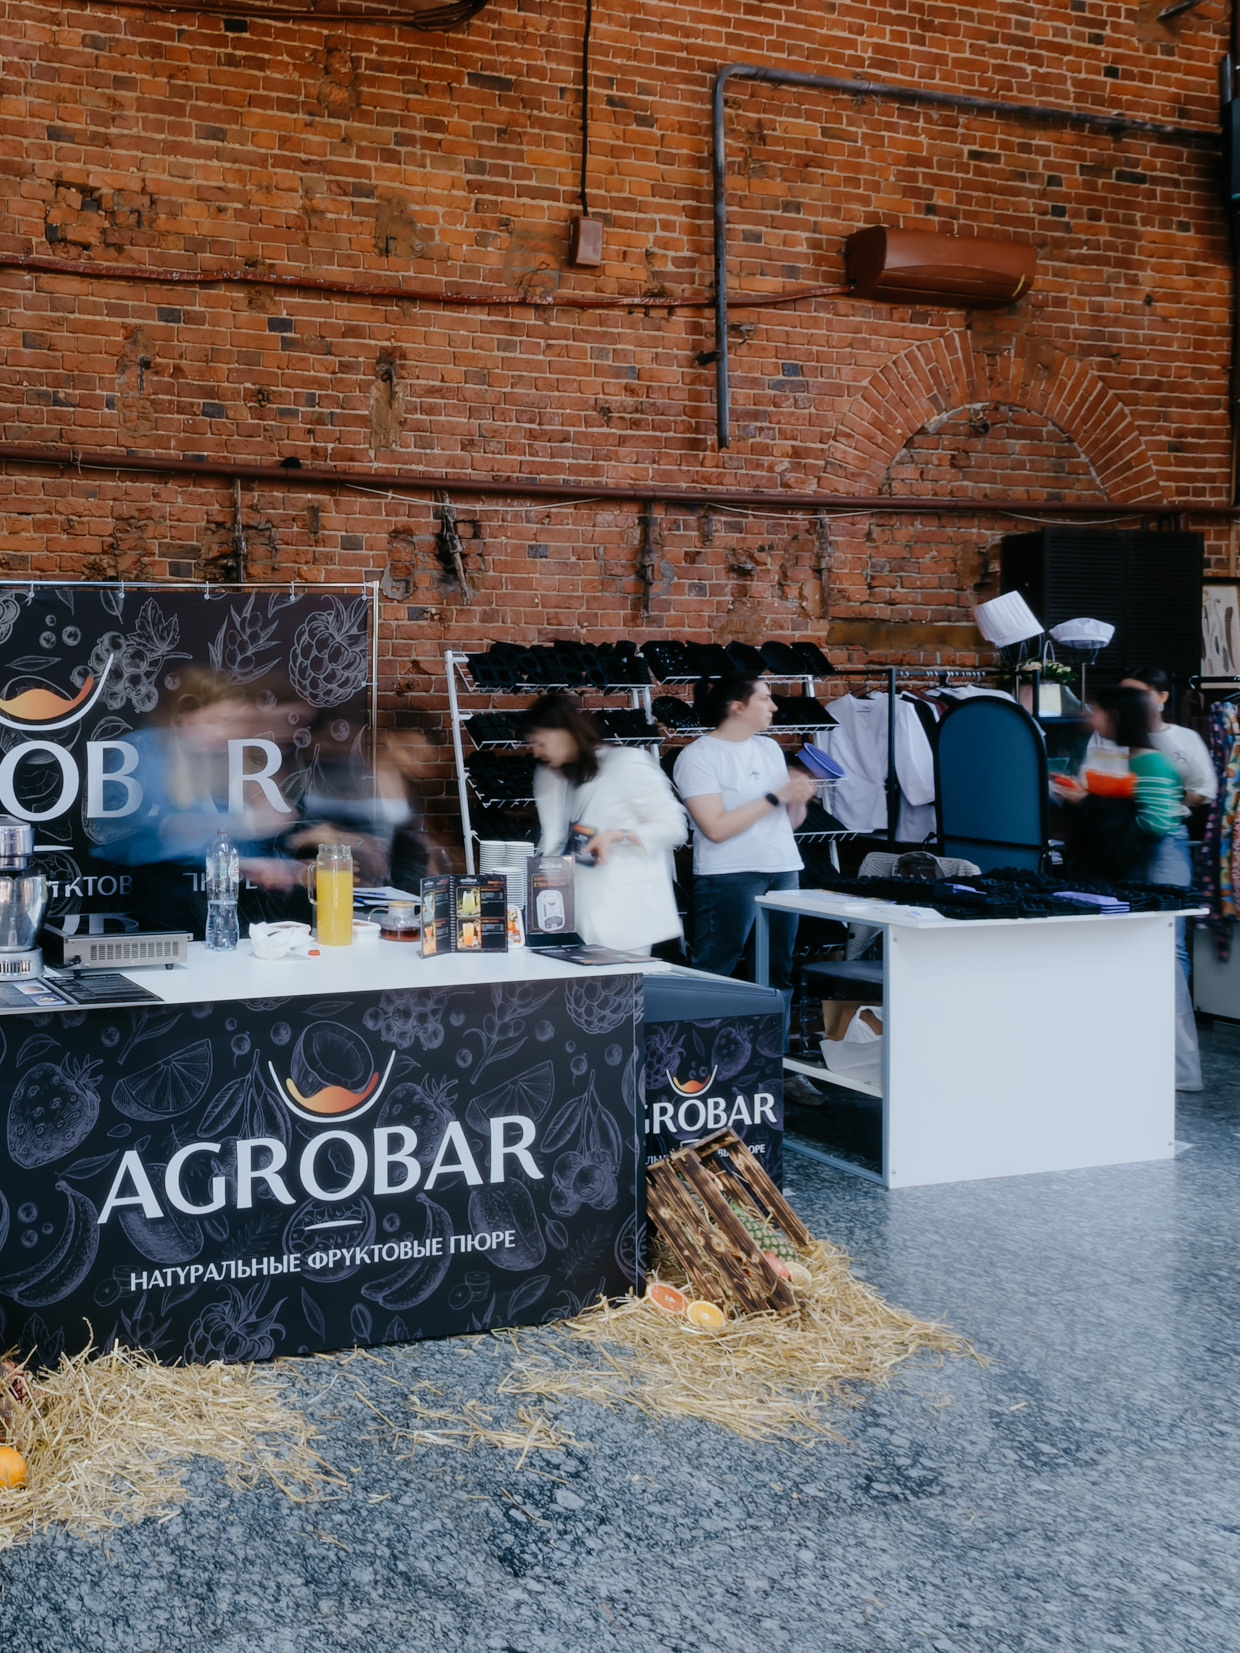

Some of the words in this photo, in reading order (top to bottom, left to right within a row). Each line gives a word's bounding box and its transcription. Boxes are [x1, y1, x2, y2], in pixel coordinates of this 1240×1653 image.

[644, 1092, 778, 1134] ROBAR
[96, 1115, 545, 1224] AGROBAR
[129, 1253, 301, 1291] НАТУРАЛЬНЫЕ
[307, 1236, 443, 1269] ФРУКТОВЫЕ
[449, 1229, 516, 1253] ПЮРЕ
